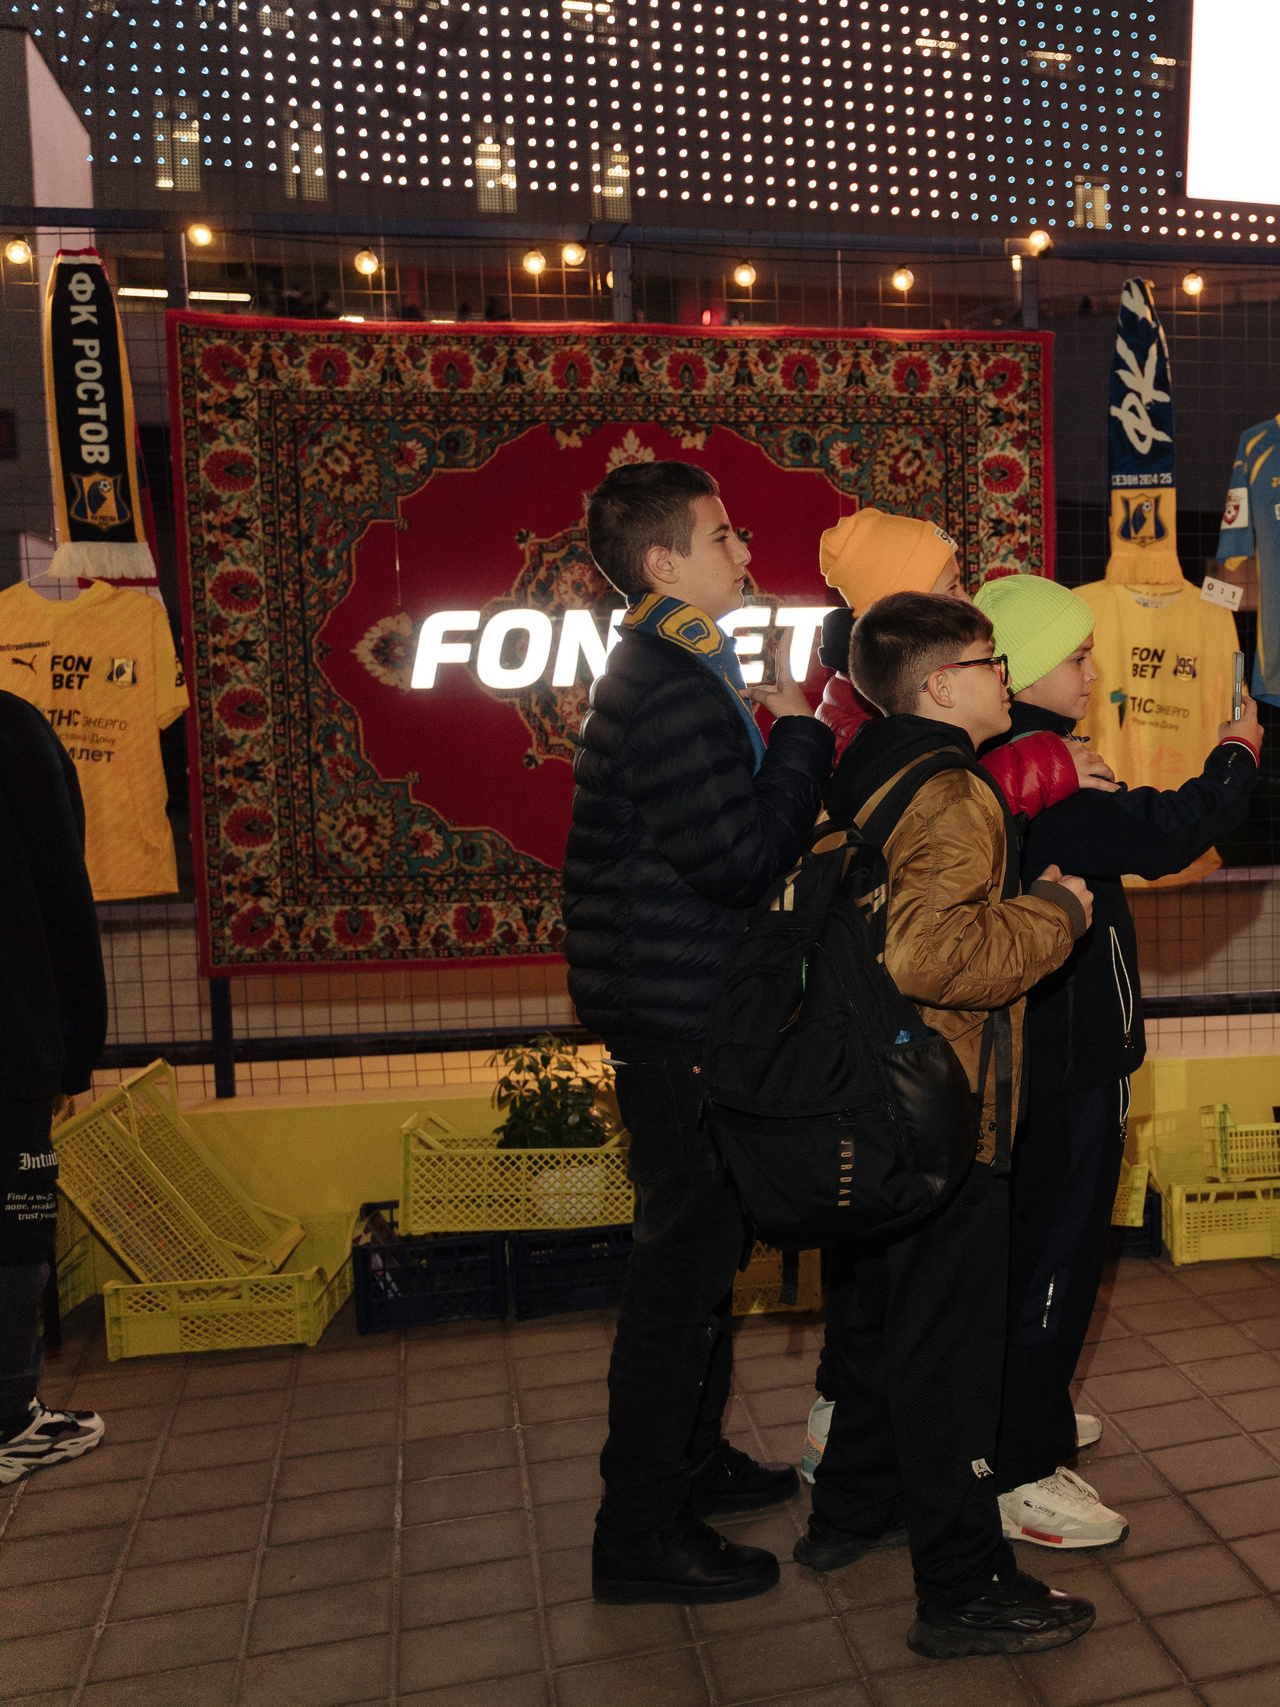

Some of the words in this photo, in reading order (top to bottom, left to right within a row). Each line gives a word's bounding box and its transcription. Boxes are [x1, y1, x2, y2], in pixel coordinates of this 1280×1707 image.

[68, 271, 99, 325] ФК
[72, 338, 111, 465] РОСТОВ
[409, 606, 838, 690] FONET
[1132, 647, 1166, 663] FON
[50, 654, 93, 672] FON
[1132, 663, 1162, 679] BET
[52, 674, 90, 690] BET
[838, 1140, 853, 1207] JORDAN
[7, 1193, 28, 1201] Find
[5, 1203, 30, 1211] none,
[18, 1212, 39, 1220] trust
[1035, 1504, 1056, 1517] LACOSTE
